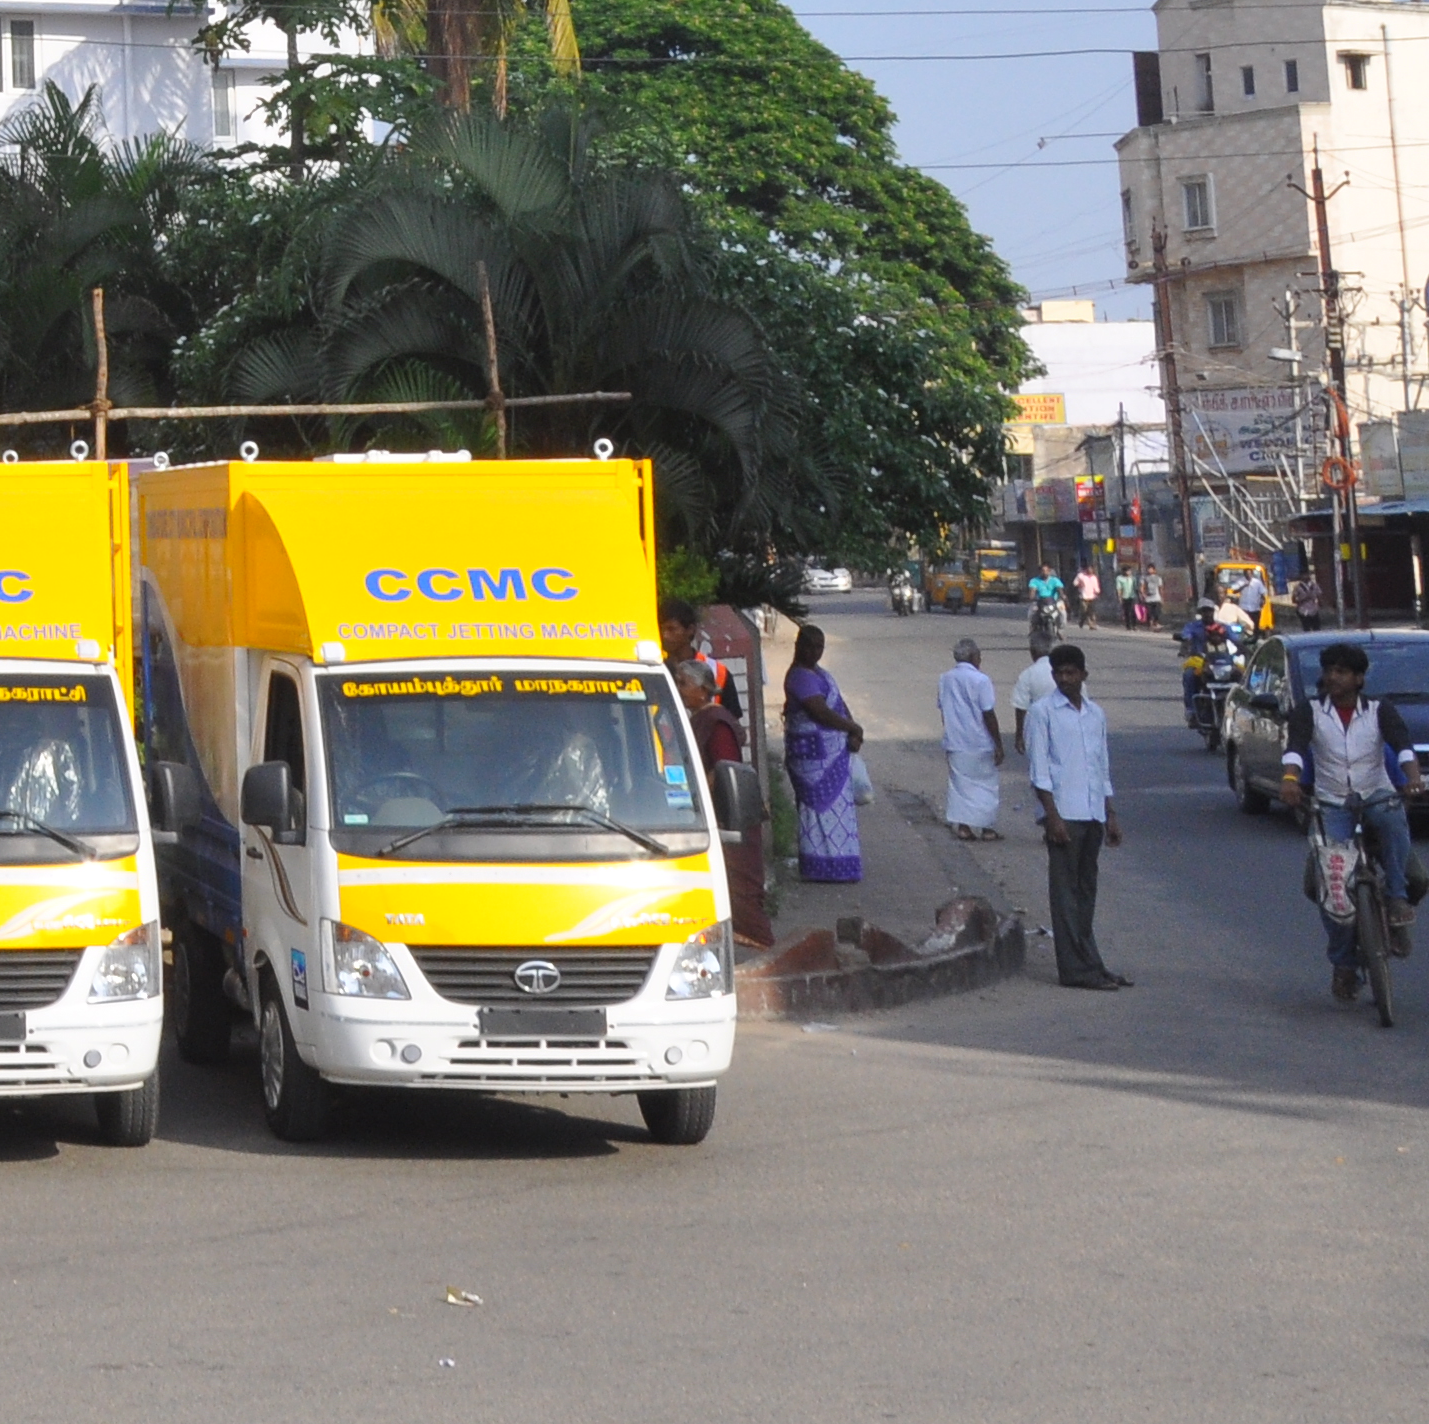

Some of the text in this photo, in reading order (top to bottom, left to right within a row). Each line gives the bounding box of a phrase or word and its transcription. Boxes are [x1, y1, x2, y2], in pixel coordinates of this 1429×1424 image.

[364, 567, 580, 602] CCMC
[337, 622, 640, 641] COMPACT JETTING MACHINE
[384, 913, 425, 926] TATA
